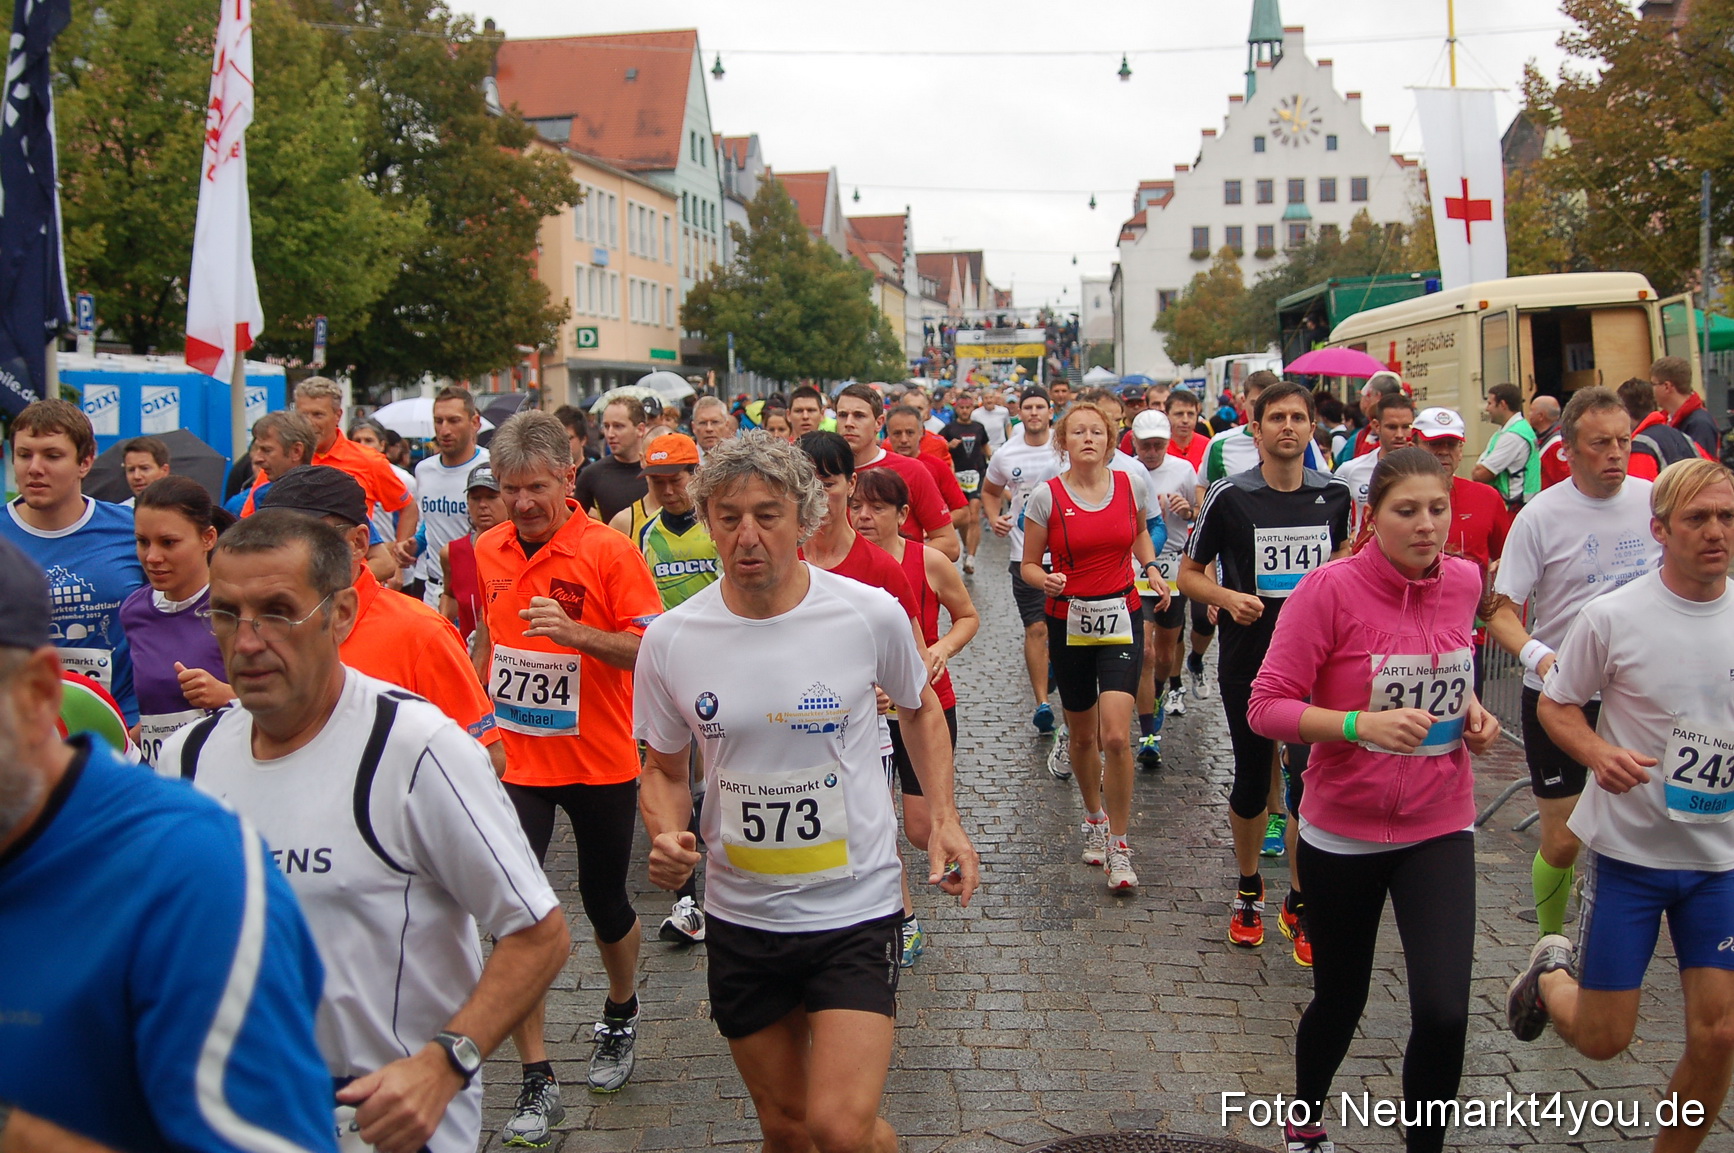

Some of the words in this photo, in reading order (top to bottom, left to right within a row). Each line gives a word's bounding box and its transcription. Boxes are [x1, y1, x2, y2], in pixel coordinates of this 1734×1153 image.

[579, 329, 596, 346] D
[1406, 332, 1455, 358] Bayerisches
[1405, 361, 1429, 378] Rotes
[142, 392, 177, 414] DIXI
[244, 391, 265, 407] IXI
[422, 495, 469, 517] Gothae
[1284, 534, 1318, 542] Neumarkt
[1264, 543, 1322, 571] 3141
[655, 559, 717, 577] BOCK
[80, 601, 121, 612] Stadtlauf
[1070, 603, 1090, 613] PARTL
[1091, 605, 1119, 613] Neumarkt
[1081, 614, 1119, 635] 547
[494, 653, 518, 666] PARTL
[519, 659, 563, 671] Neumarkt
[1416, 664, 1461, 676] Neumarkt
[497, 668, 571, 706] 2734
[1381, 677, 1466, 717] 3123
[510, 708, 554, 726] Michael
[766, 712, 788, 723] 14.
[1672, 727, 1710, 746] PARTL
[1713, 738, 1734, 751] Neu
[1671, 746, 1734, 788] 243
[720, 779, 756, 795] PARTL
[758, 780, 820, 796] Neumarkt
[1689, 795, 1728, 811] Stefan
[741, 798, 822, 843] 573
